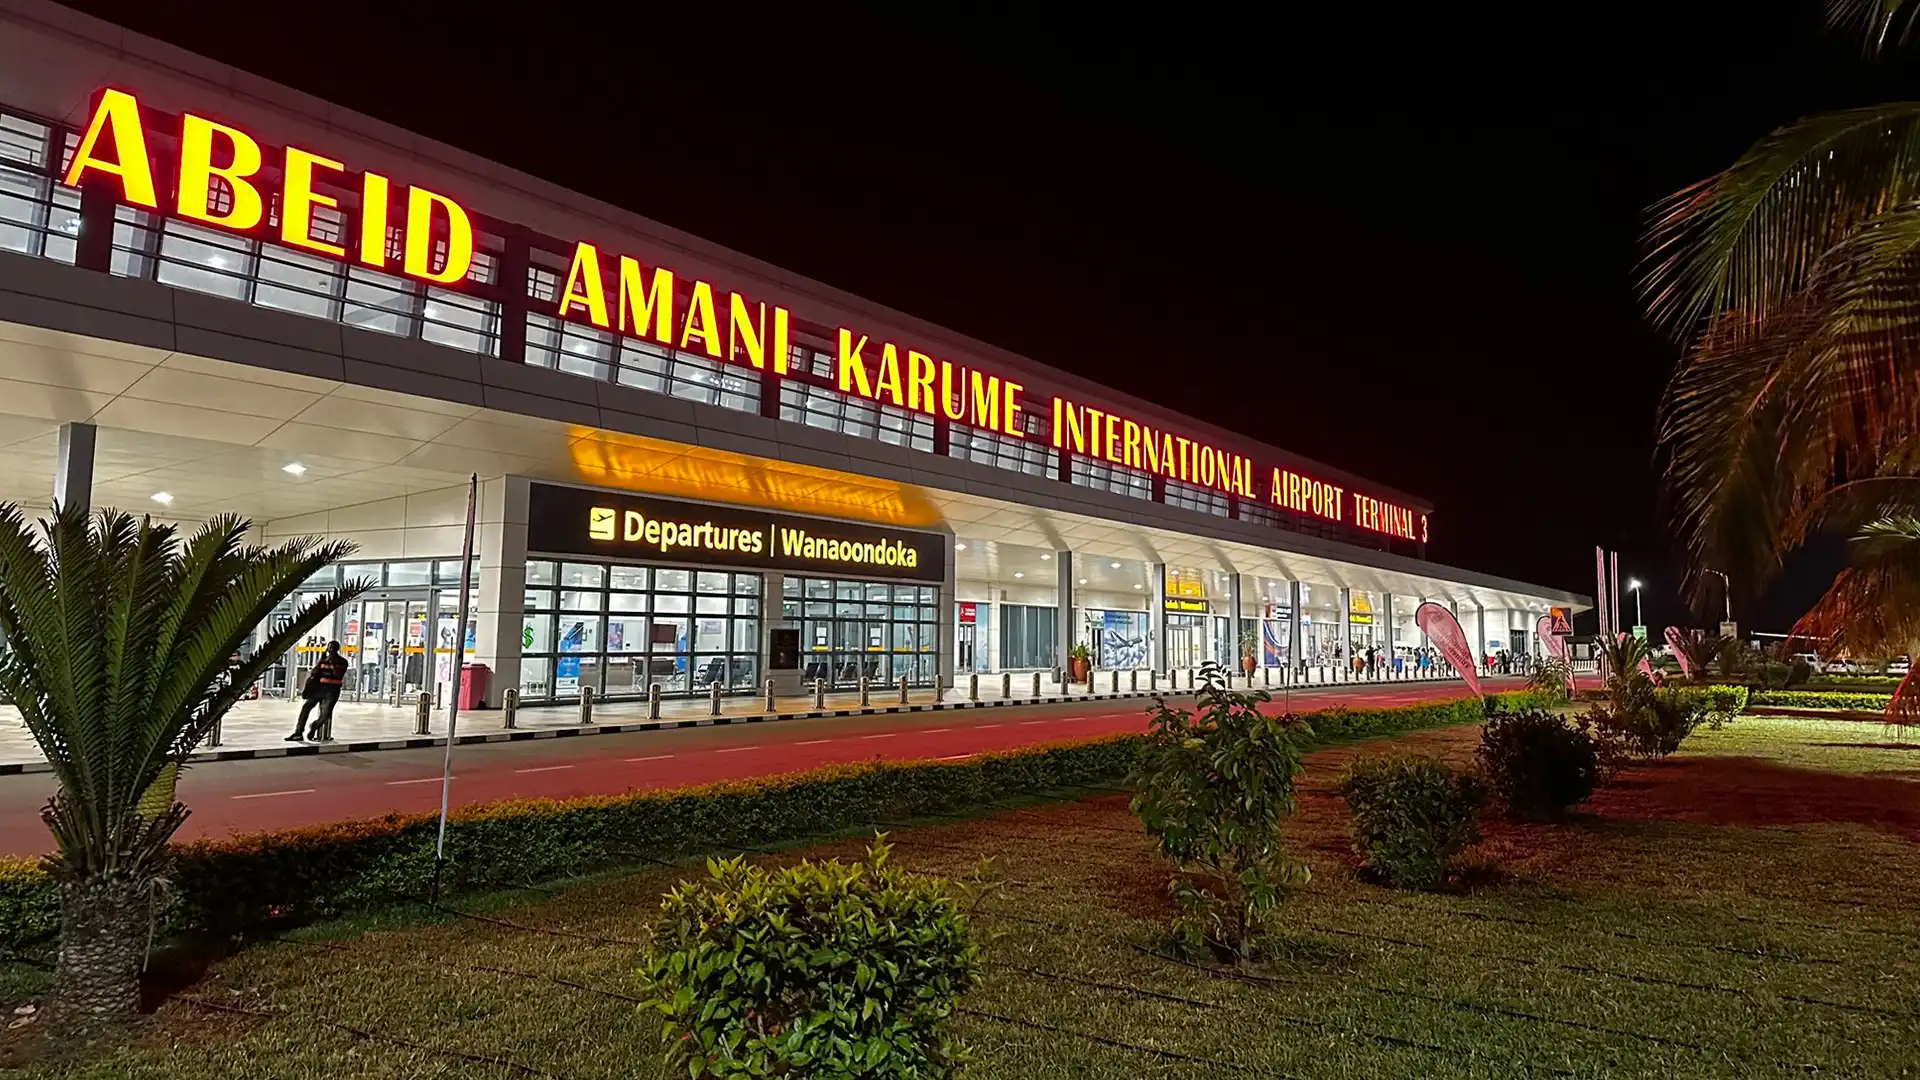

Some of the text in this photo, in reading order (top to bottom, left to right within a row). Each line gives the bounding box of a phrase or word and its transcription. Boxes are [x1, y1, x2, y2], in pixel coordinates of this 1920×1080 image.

[64, 88, 1428, 543] ABEID AMANI KARUME INTERNATIONAL AIRPORT TERMINAL 3
[623, 510, 918, 569] Departures Wanaoondoka
